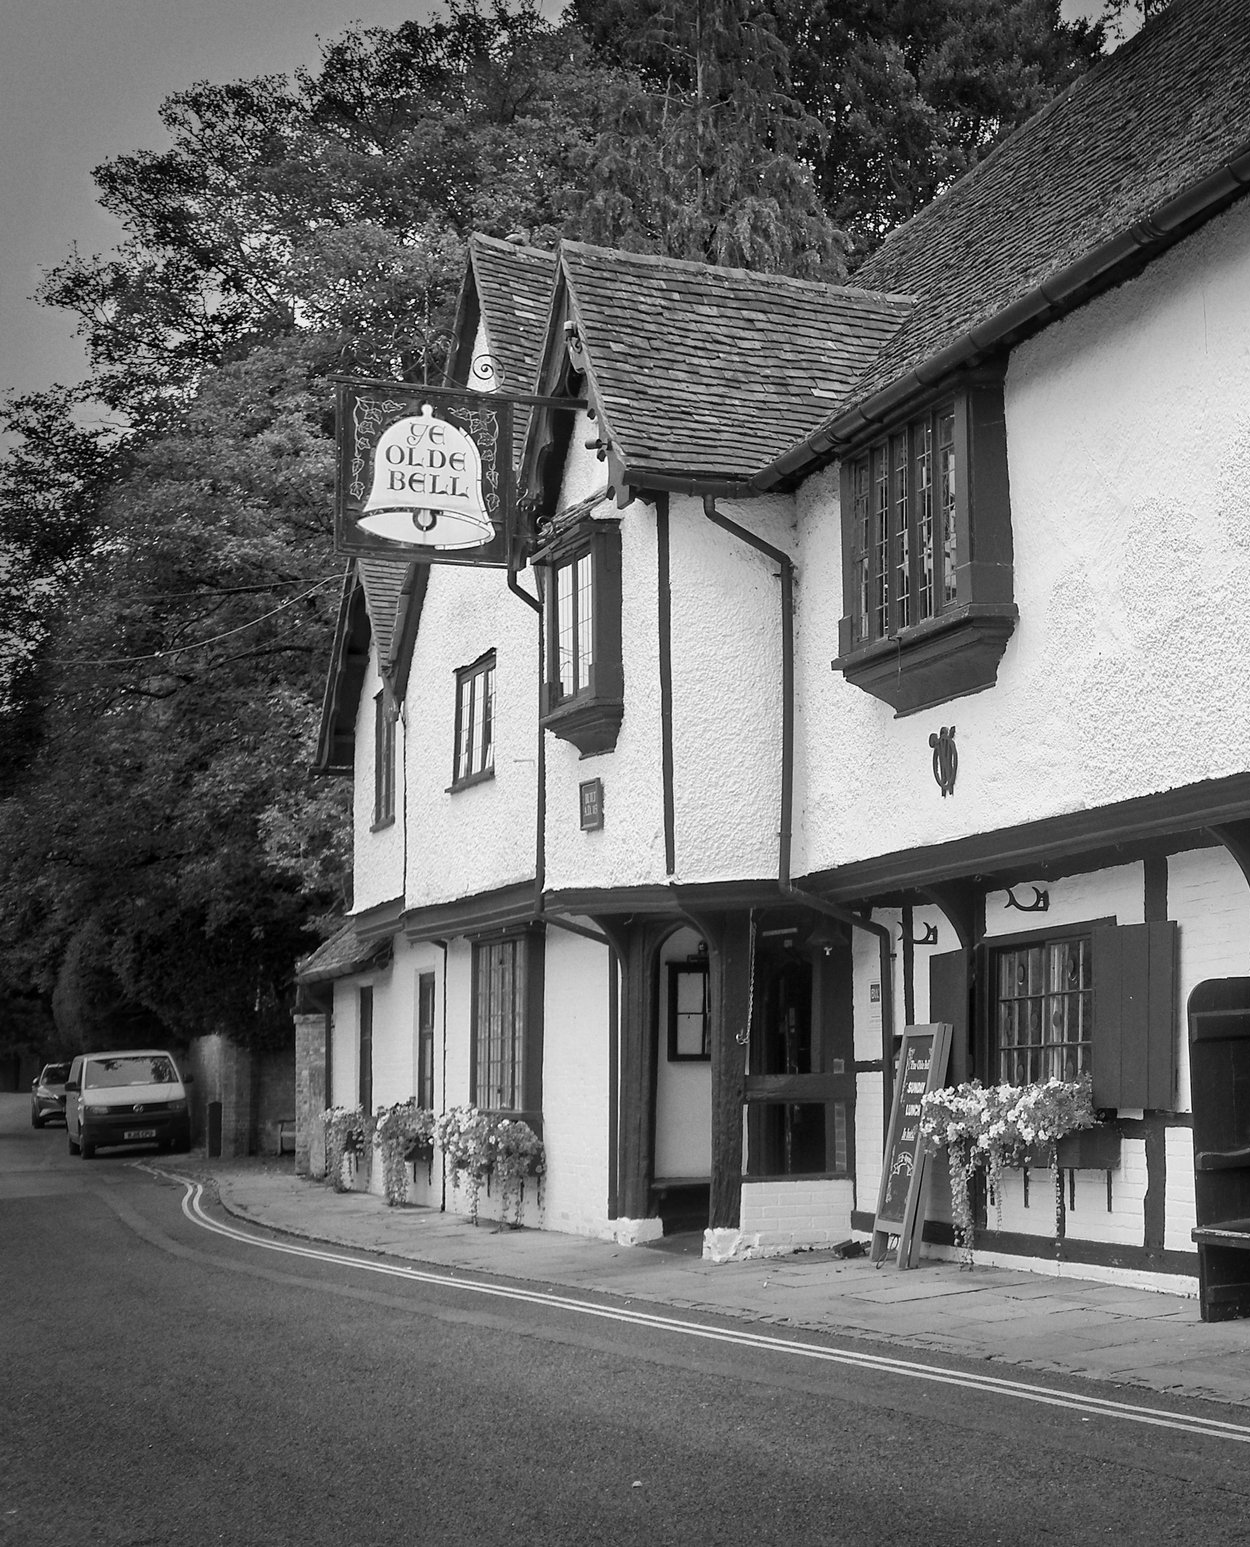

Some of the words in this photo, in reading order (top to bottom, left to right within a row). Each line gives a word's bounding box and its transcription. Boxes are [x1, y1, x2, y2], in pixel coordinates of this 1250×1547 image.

[385, 444, 467, 472] OLDE
[386, 469, 470, 498] BELL
[905, 1104, 921, 1116] LUNCH
